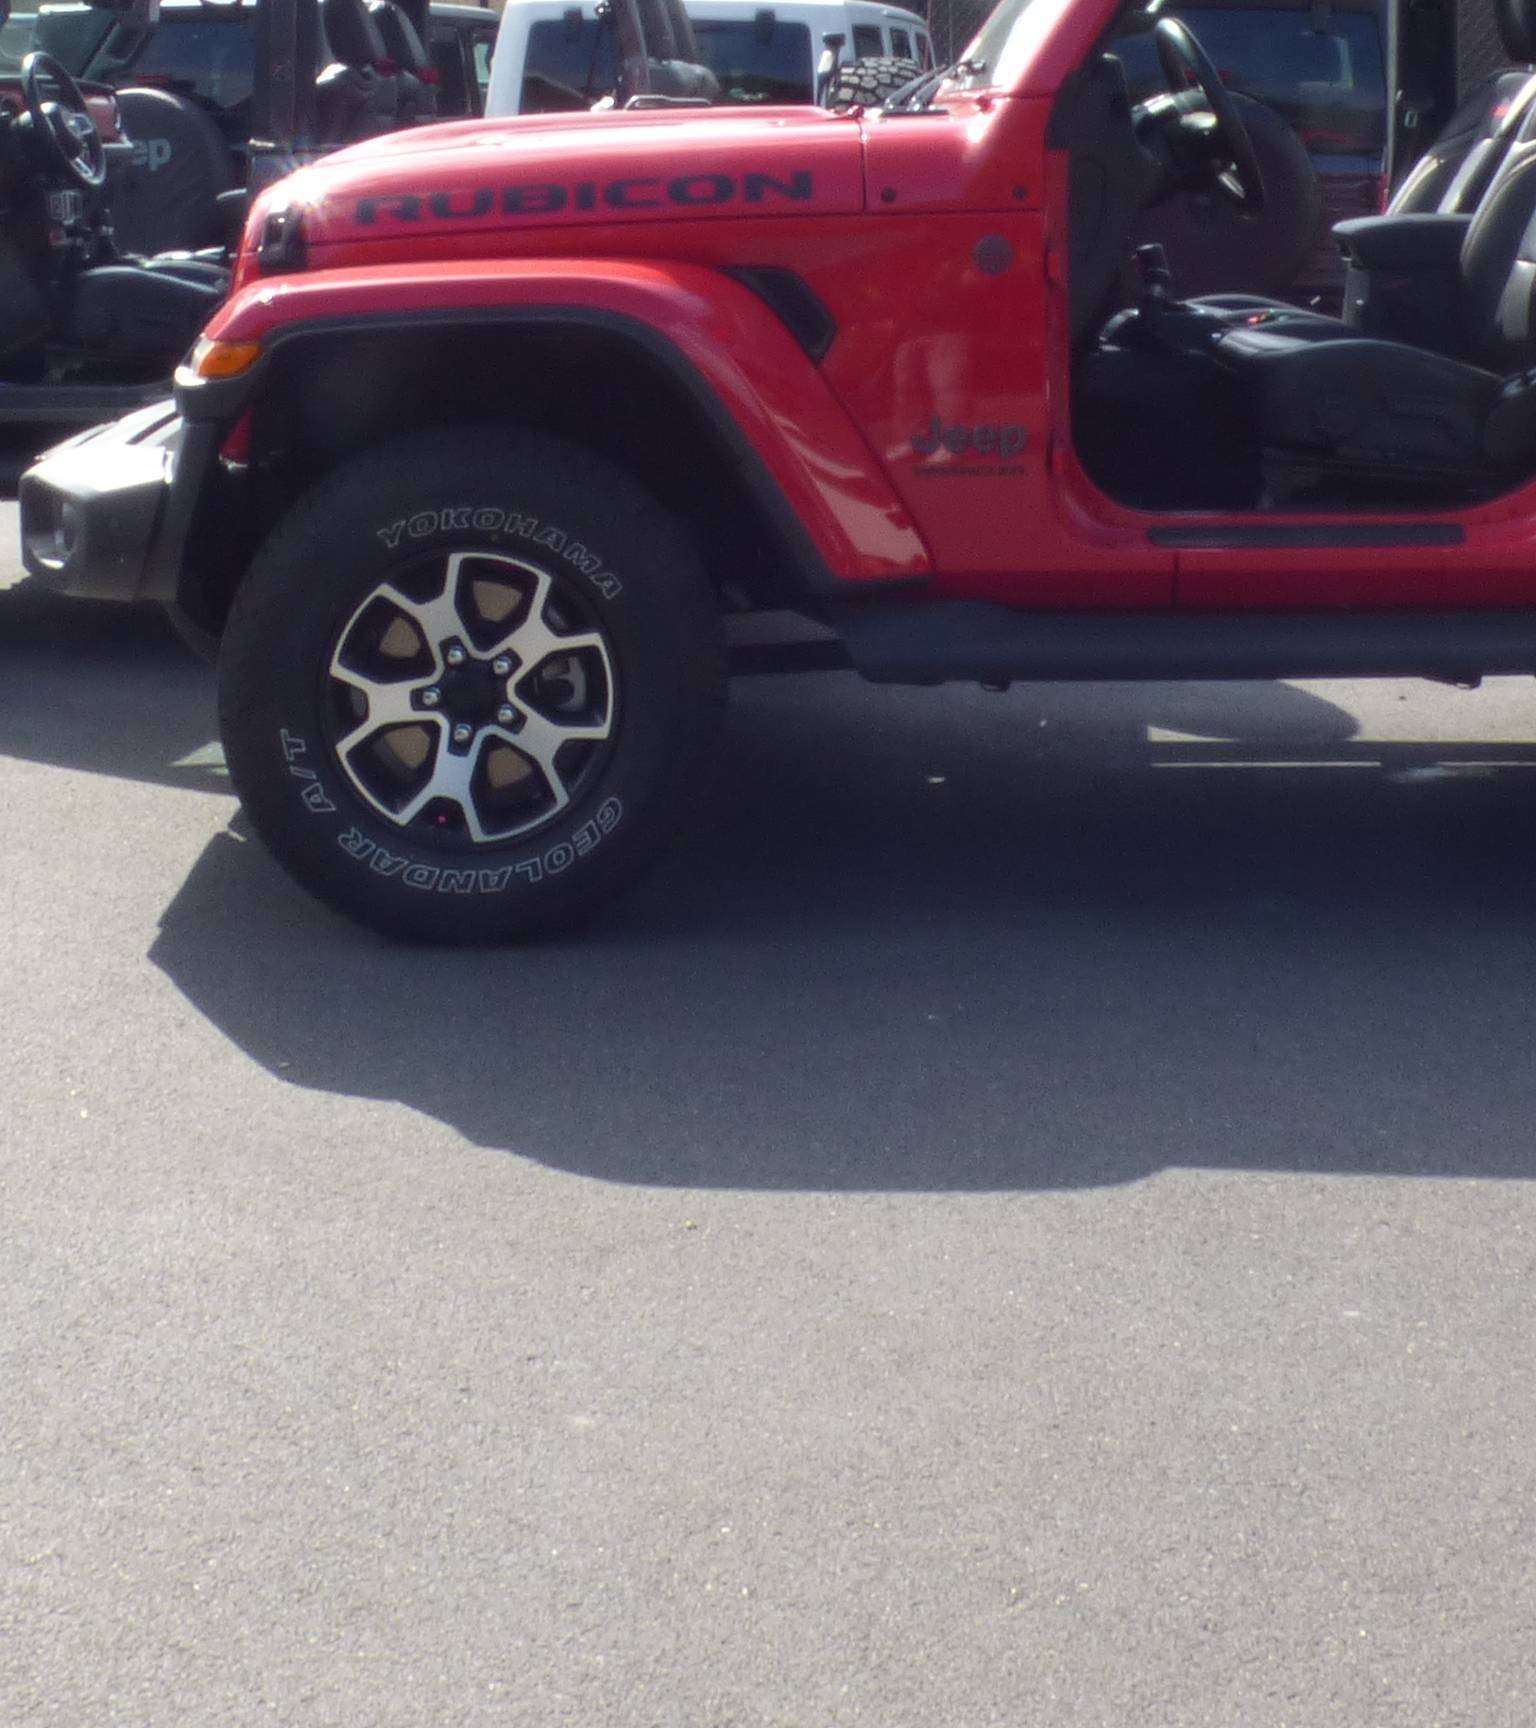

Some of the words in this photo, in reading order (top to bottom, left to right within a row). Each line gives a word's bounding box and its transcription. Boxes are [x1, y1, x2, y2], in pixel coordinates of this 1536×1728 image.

[355, 171, 812, 225] RUBICON
[911, 415, 1027, 459] Jeep
[376, 506, 623, 601] YOKOHAMA
[279, 728, 336, 813] A/T
[339, 795, 624, 894] GEOLANDAR
